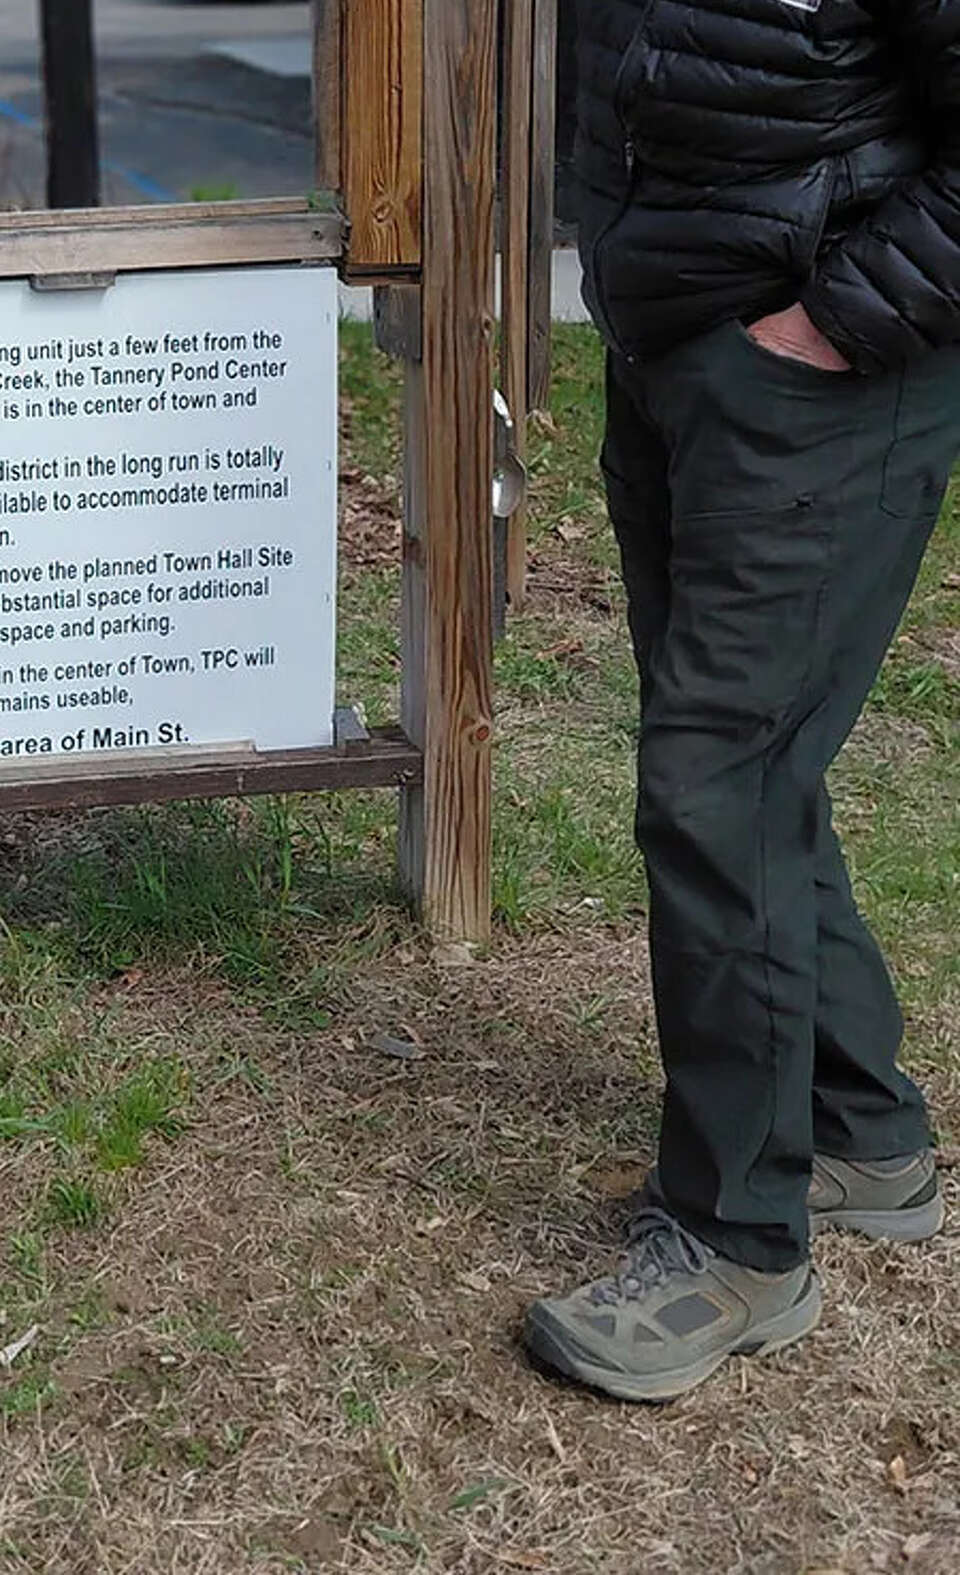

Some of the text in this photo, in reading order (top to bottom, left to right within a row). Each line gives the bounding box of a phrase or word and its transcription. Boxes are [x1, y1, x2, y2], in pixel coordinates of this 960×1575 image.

[26, 339, 65, 360] unit
[67, 338, 104, 363] just
[108, 341, 120, 356] a
[124, 335, 158, 355] few
[162, 333, 198, 353] feet
[203, 331, 247, 351] from
[252, 329, 282, 349] the
[54, 368, 84, 387] the
[90, 365, 168, 387] Tannery
[170, 360, 219, 381] Pond
[222, 359, 287, 378] Center
[3, 399, 20, 419] is
[25, 398, 43, 417] in
[48, 396, 78, 416] the
[82, 395, 143, 414] center
[146, 390, 167, 411] of
[170, 389, 216, 410] town
[222, 386, 256, 407] and
[52, 490, 72, 511] to
[76, 482, 208, 509] accommodate
[212, 476, 288, 501] terminal
[60, 728, 86, 753] of
[92, 725, 149, 750] Main
